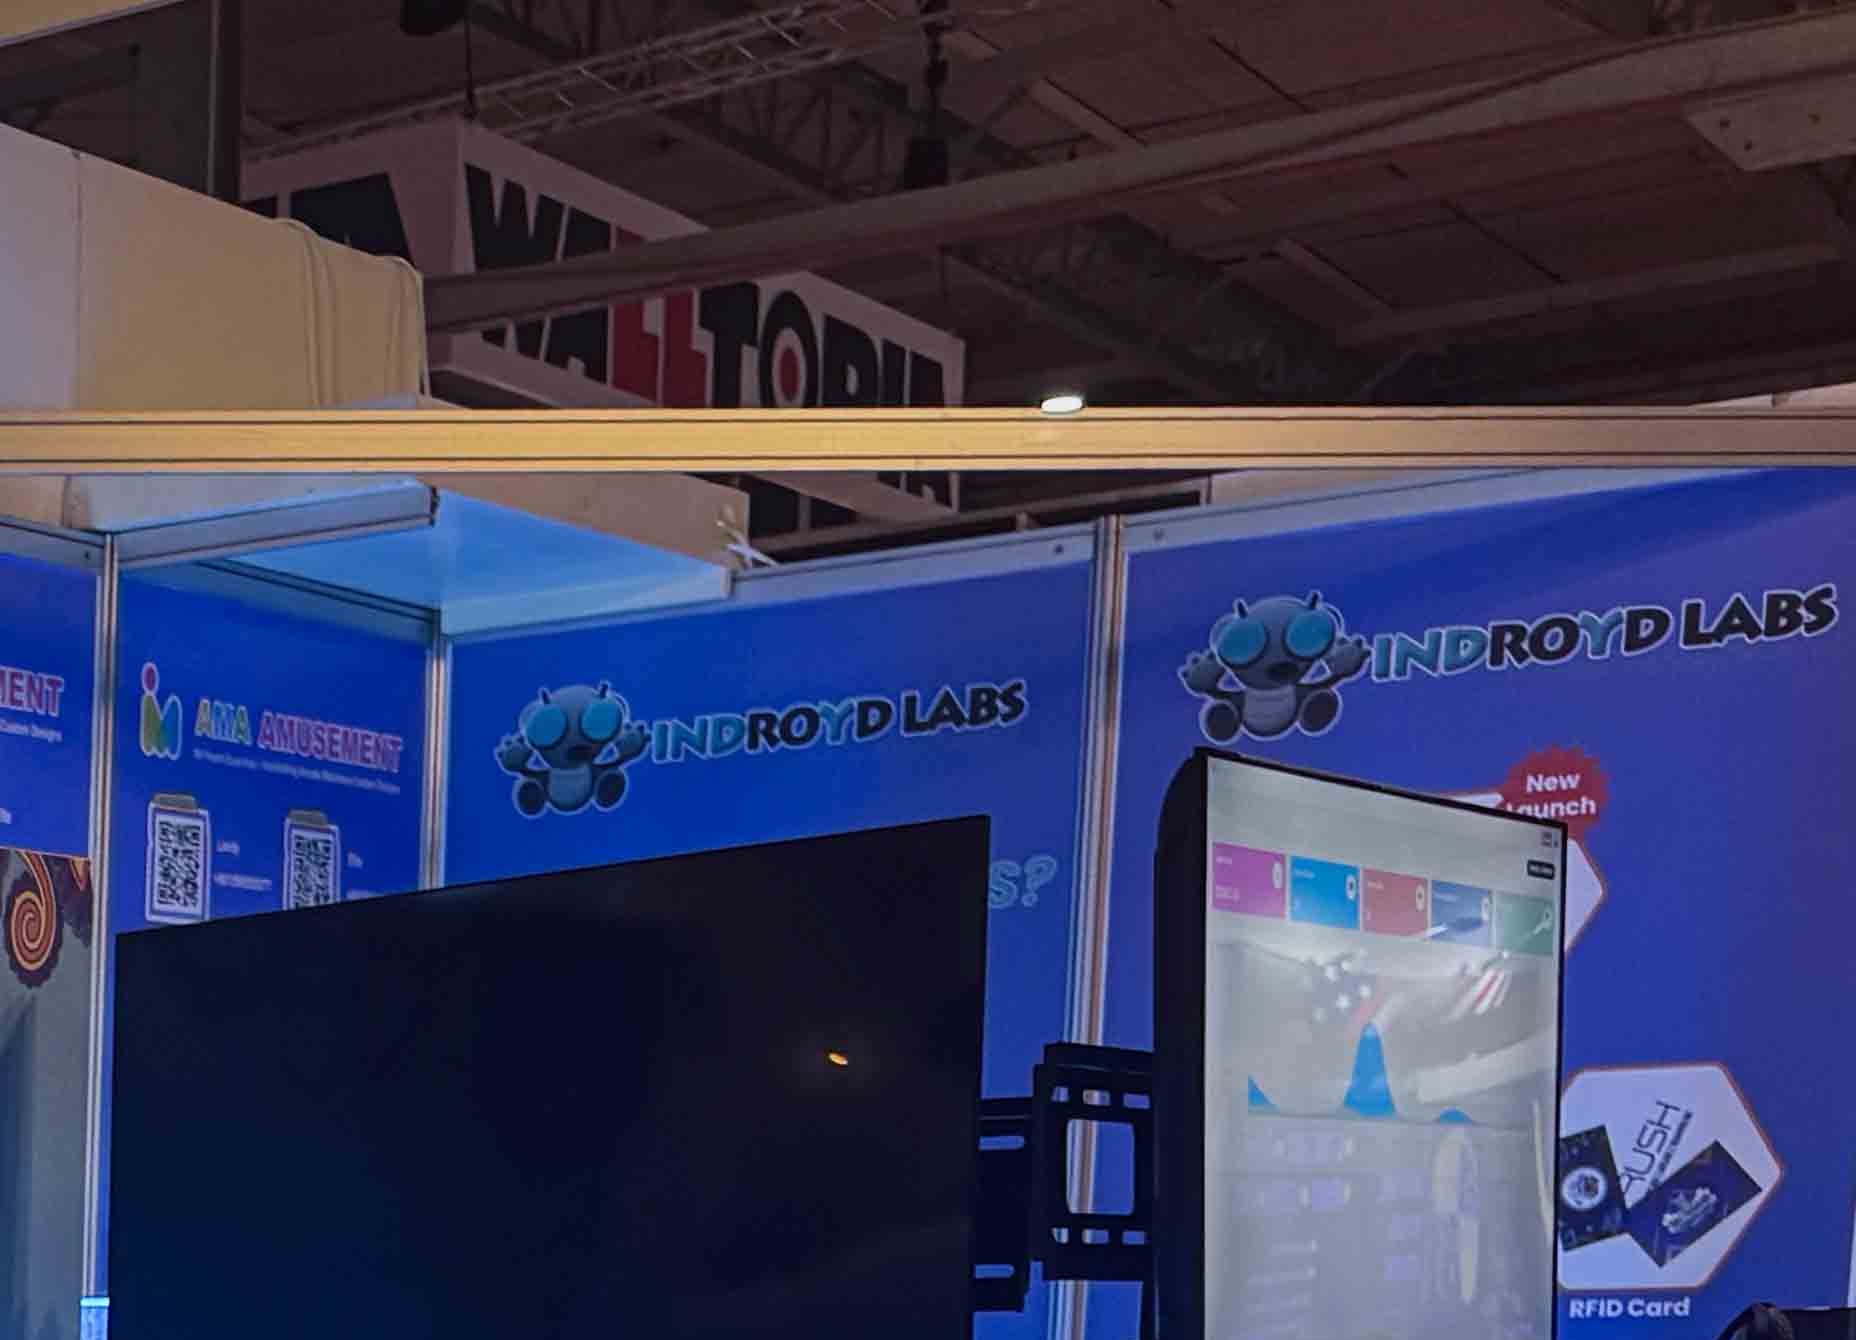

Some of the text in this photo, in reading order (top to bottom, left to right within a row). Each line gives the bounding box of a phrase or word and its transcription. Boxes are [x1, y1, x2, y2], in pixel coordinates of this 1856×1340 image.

[1372, 583, 1838, 684] INDROYD LABS
[257, 708, 402, 775] AMUSEMENT
[652, 679, 1027, 764] INDROYD LABS
[1525, 773, 1581, 793] New
[1569, 1297, 1691, 1319] RFID Card
